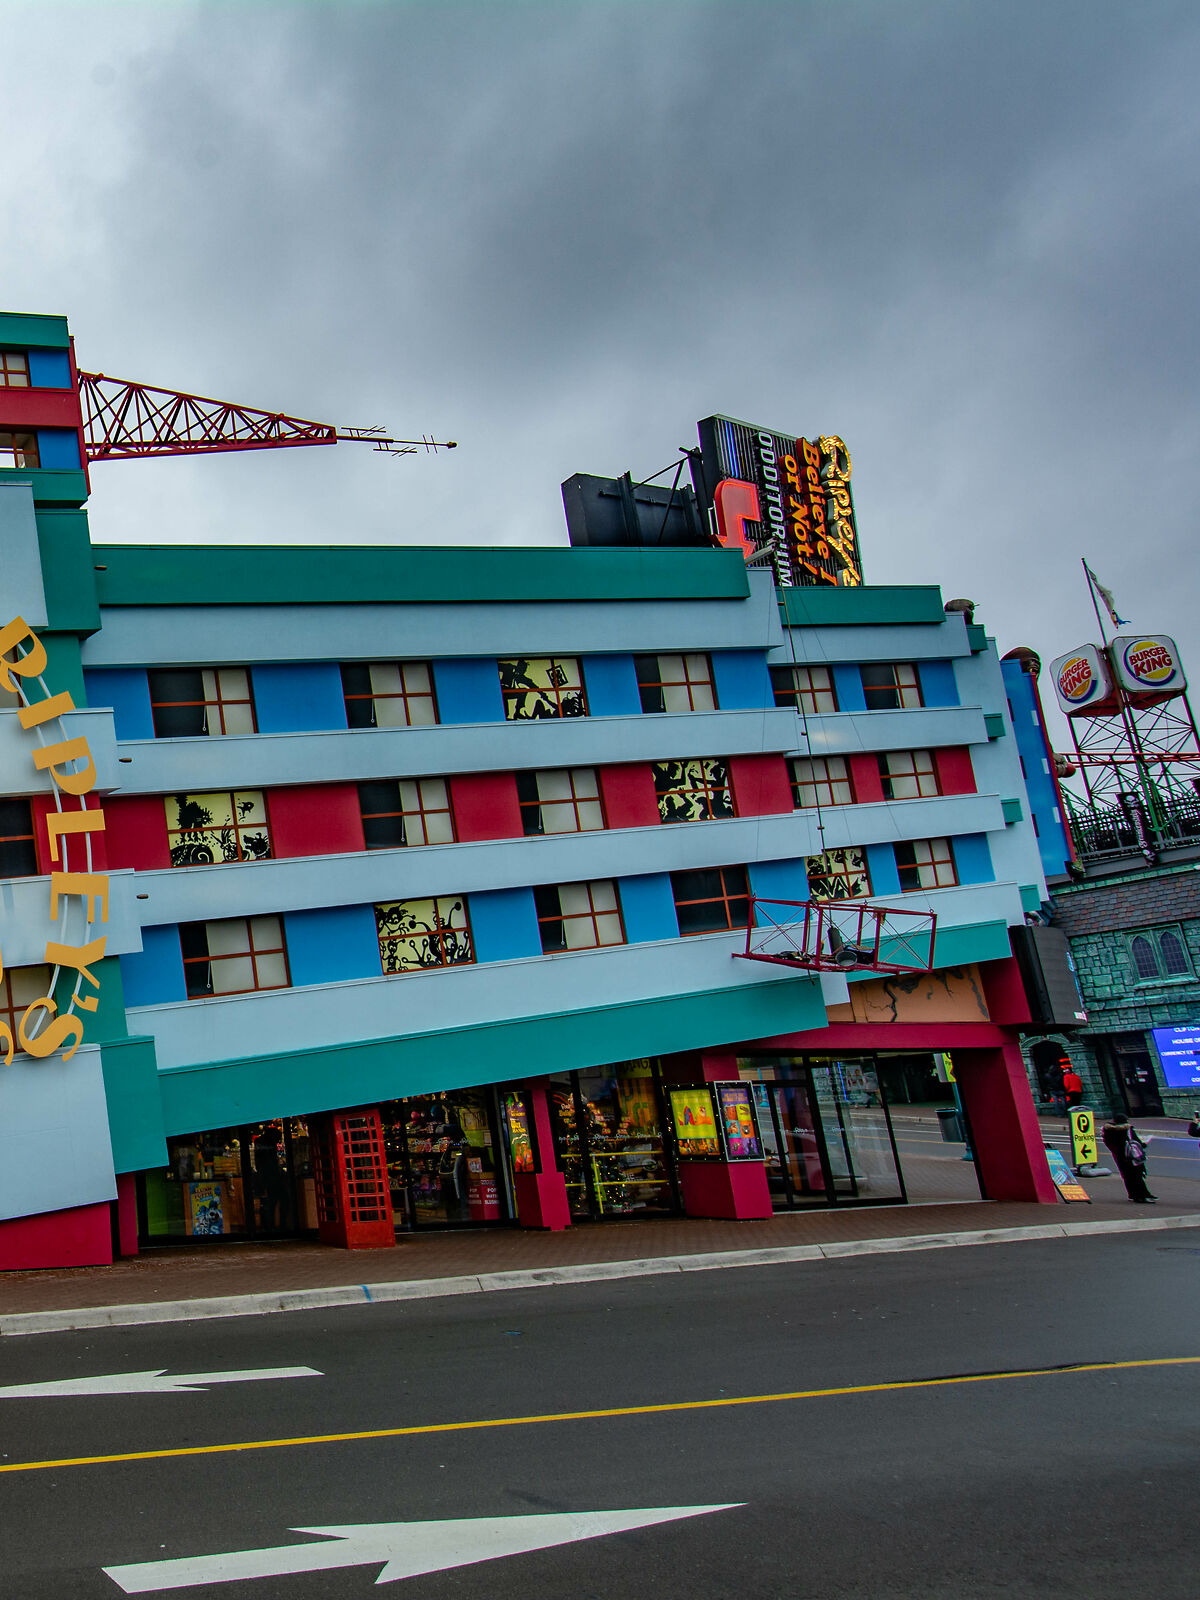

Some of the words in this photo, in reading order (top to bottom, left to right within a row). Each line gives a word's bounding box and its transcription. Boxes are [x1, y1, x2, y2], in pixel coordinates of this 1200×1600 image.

[783, 454, 802, 493] or
[801, 437, 830, 560] Believe
[790, 496, 818, 576] Not!
[1128, 646, 1168, 666] BURGER
[1133, 653, 1174, 679] KING
[1059, 658, 1090, 688] BURGER
[1062, 665, 1093, 698] KING
[1074, 1133, 1095, 1142] Parking
